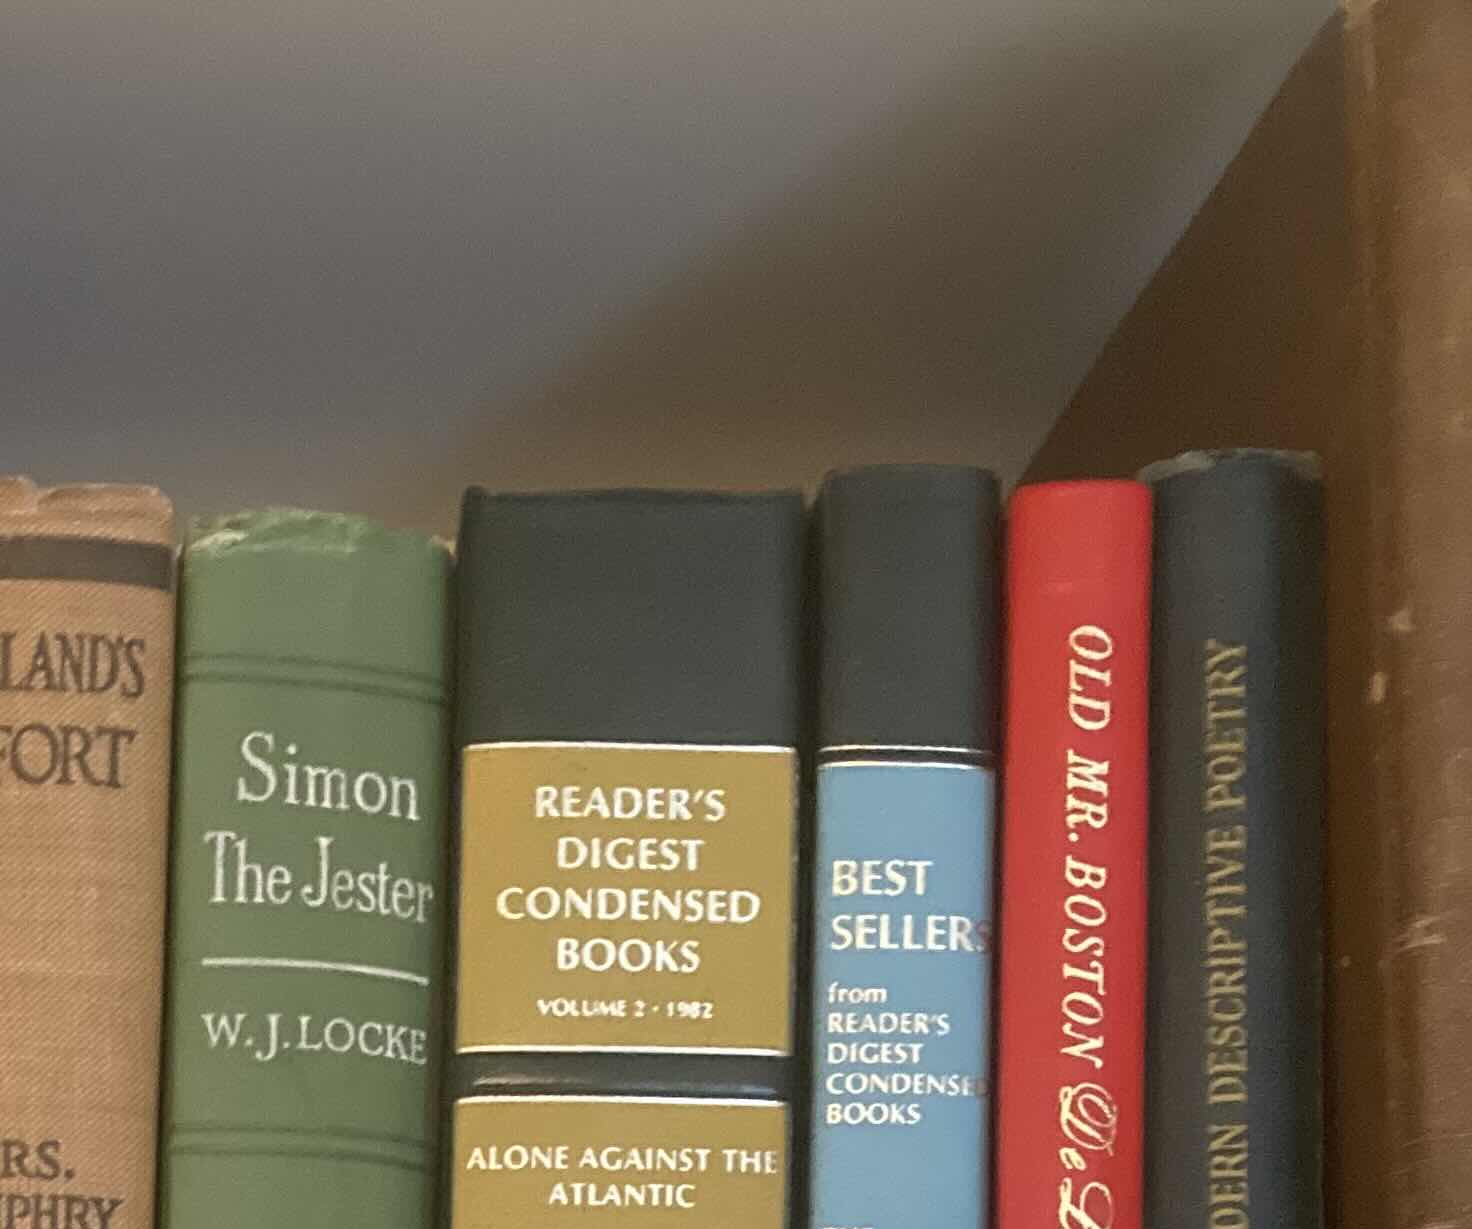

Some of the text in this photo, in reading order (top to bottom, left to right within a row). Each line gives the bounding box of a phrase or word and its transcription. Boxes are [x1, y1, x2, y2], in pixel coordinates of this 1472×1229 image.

[1067, 623, 1115, 732] OLD
[1204, 637, 1249, 812] POETRY
[236, 730, 421, 821] Simon
[534, 785, 726, 822] READER'S
[1064, 748, 1112, 843] MR.
[556, 836, 705, 871] DIGEST
[203, 830, 435, 924] The Jester
[830, 858, 935, 897] BEST
[495, 885, 762, 924] CONDENSED
[556, 936, 701, 974] BOOKS
[1059, 854, 1109, 1070] BOSTON
[1204, 824, 1249, 1104] DESCRIPTIVE
[536, 998, 715, 1020] VOLUME 2 1982
[827, 981, 889, 1005] from
[827, 1011, 952, 1036] READER'S
[826, 1041, 926, 1065] DIGEST
[825, 1101, 922, 1126] BOOKS
[466, 1144, 778, 1175] ALONE AGAINST THE
[547, 1181, 697, 1209] ATLANTIC
